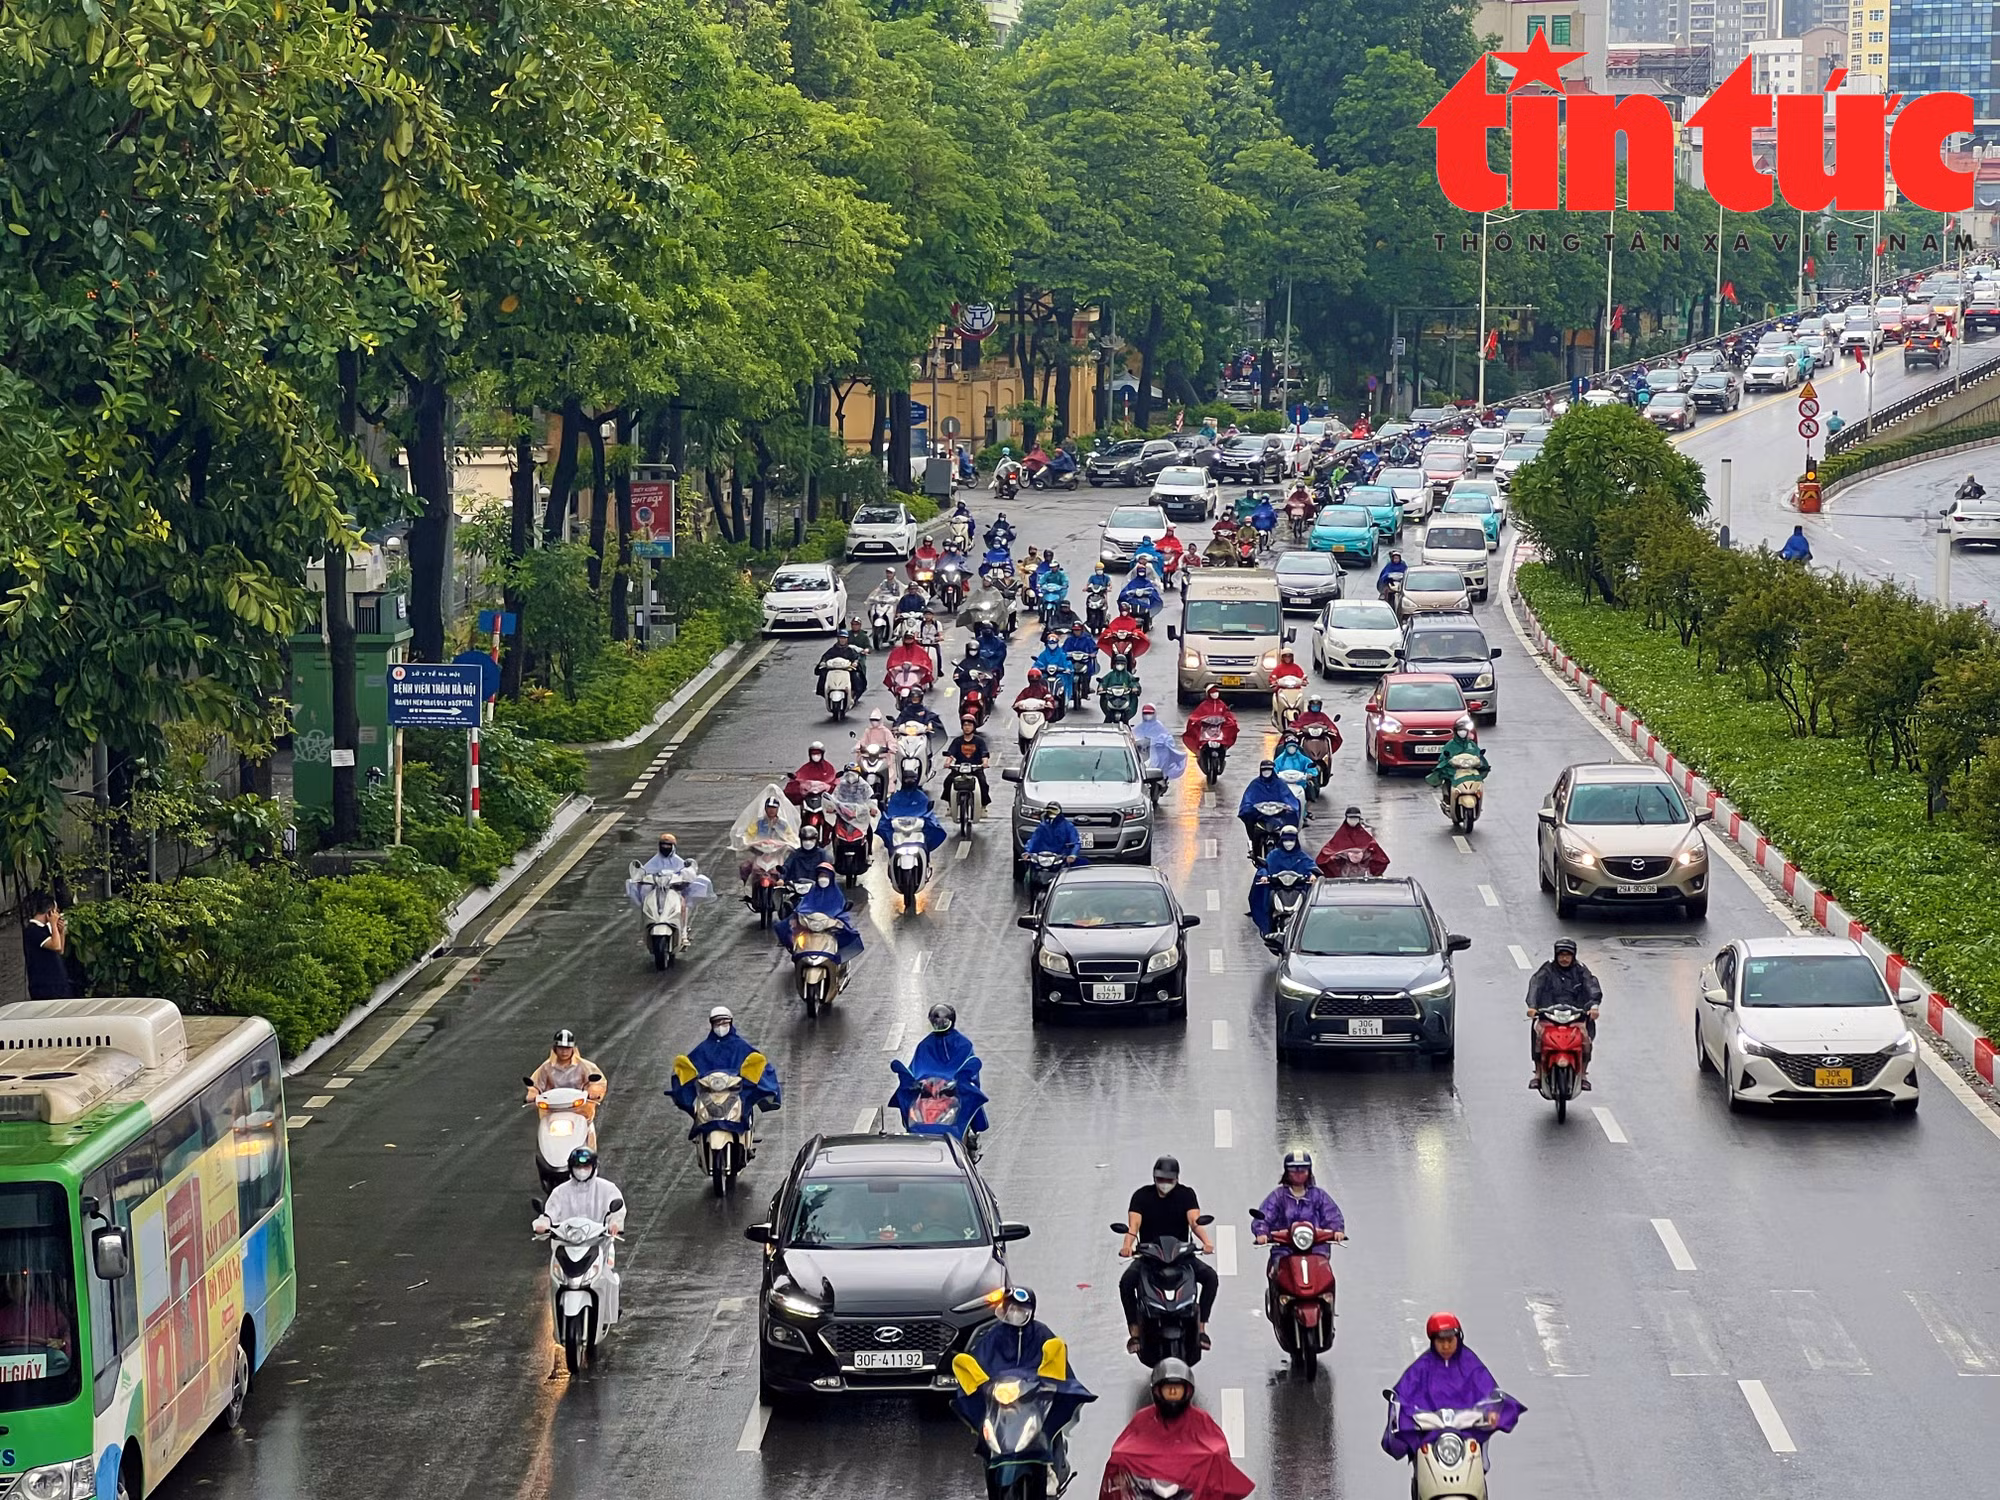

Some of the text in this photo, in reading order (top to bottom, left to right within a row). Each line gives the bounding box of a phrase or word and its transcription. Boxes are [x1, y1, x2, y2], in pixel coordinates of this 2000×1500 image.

[631, 496, 647, 504] GHT
[393, 682, 476, 698] BỆNH VIỆN THẬN HÀ NỘI
[856, 1353, 921, 1367] 30F-411.92
[12, 1358, 42, 1381] GIẤY
